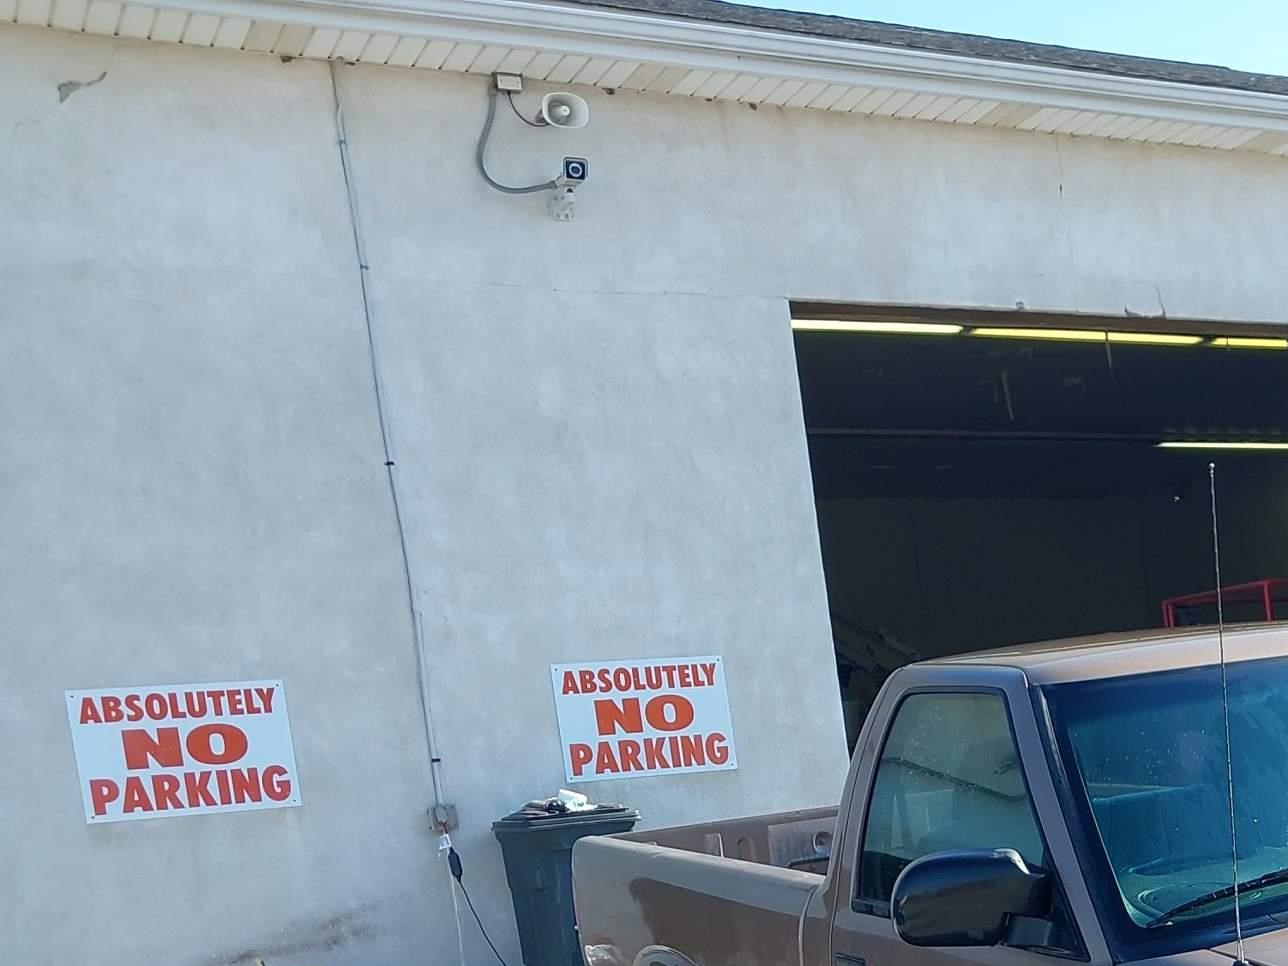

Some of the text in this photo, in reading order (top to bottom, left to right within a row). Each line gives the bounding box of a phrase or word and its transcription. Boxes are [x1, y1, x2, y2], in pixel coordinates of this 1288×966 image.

[562, 663, 716, 695] ABSOLUTELY
[80, 688, 275, 724] ABSOLUTELY
[594, 694, 694, 736] NO
[120, 723, 249, 771] NO
[570, 732, 729, 776] PARKING
[88, 764, 292, 816] PARKING
